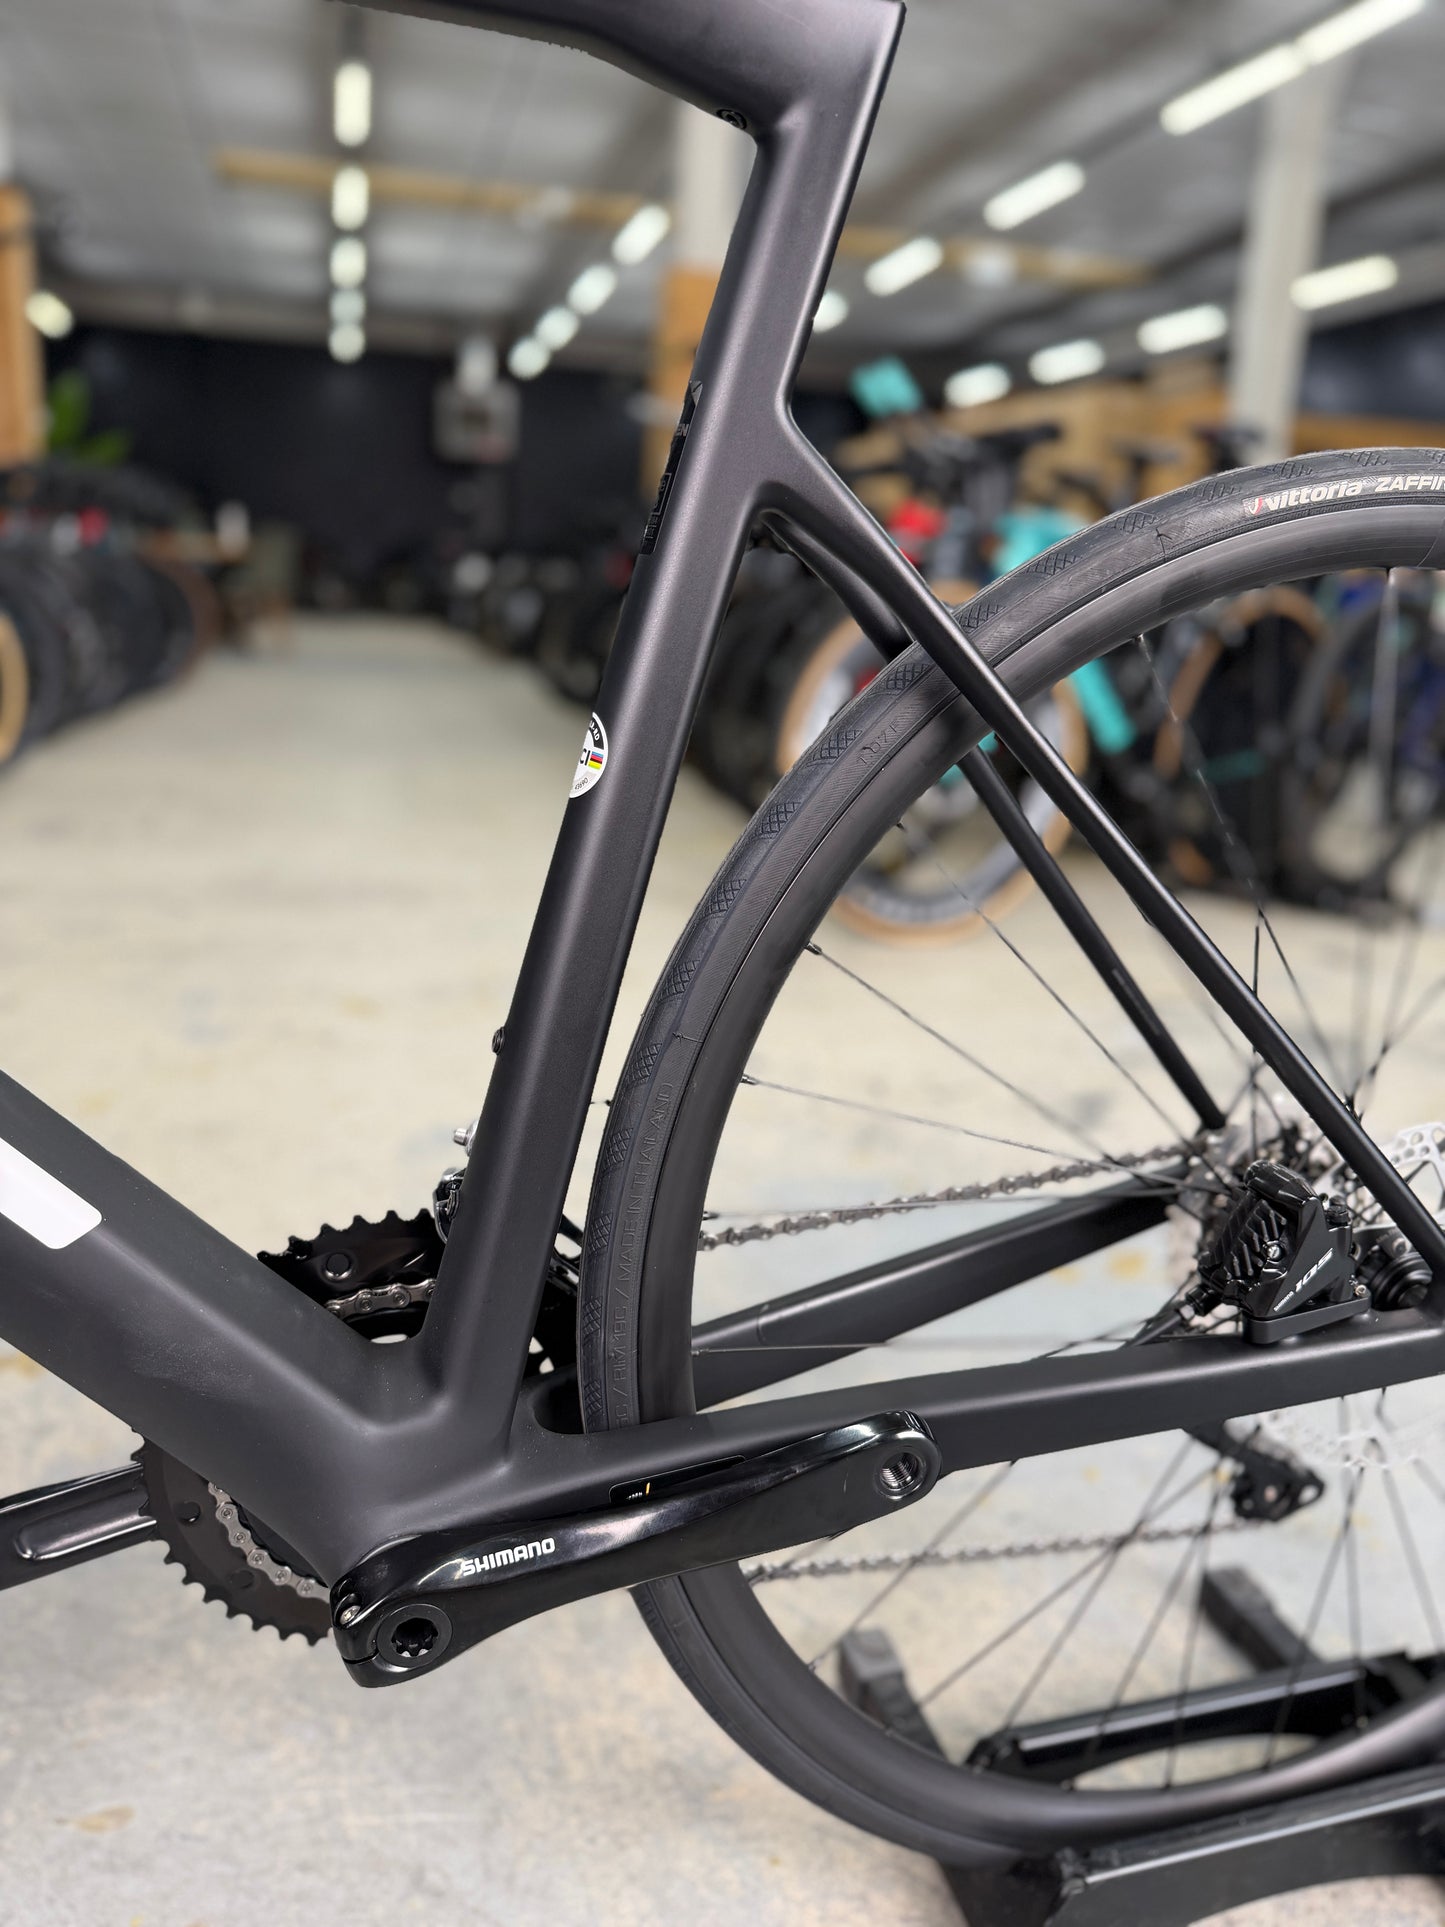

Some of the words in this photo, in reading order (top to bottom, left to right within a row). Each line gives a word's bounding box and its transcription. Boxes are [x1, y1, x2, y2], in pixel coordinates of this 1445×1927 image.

[633, 1082, 675, 1192] THAILAND
[627, 1195, 641, 1214] IN
[617, 1220, 637, 1282] MADE
[1295, 1247, 1334, 1293] 105
[613, 1345, 627, 1382] RIM
[461, 1537, 556, 1577] SHIMANO
